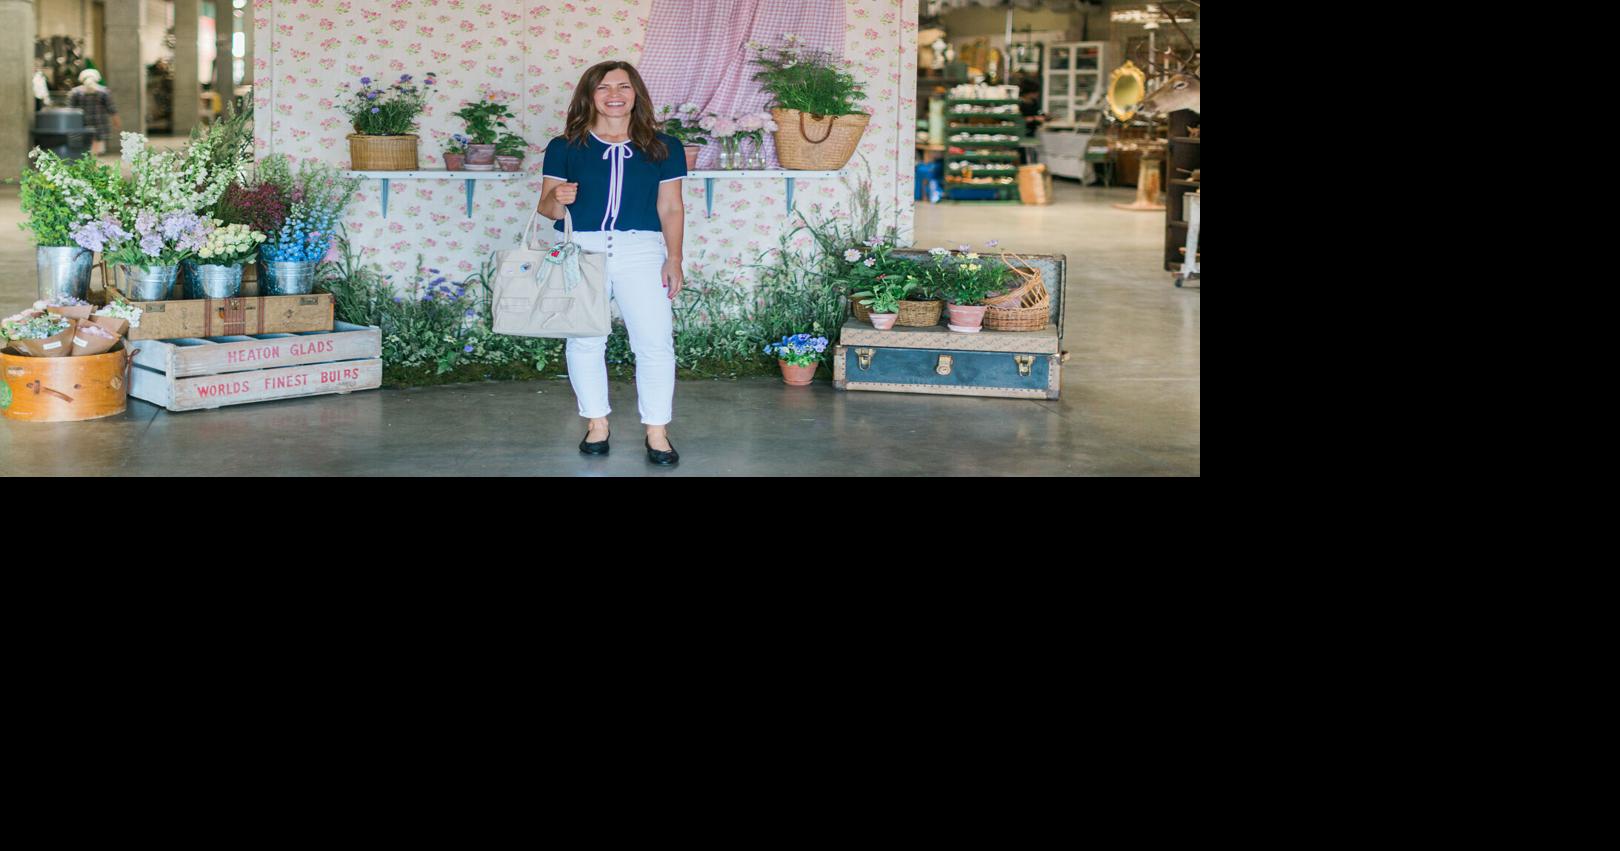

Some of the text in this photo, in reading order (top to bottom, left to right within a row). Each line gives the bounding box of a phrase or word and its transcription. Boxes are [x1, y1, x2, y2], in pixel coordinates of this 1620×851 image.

[227, 340, 334, 364] HEATON GLADS
[197, 381, 249, 398] WORLDS
[264, 374, 308, 389] FINEST
